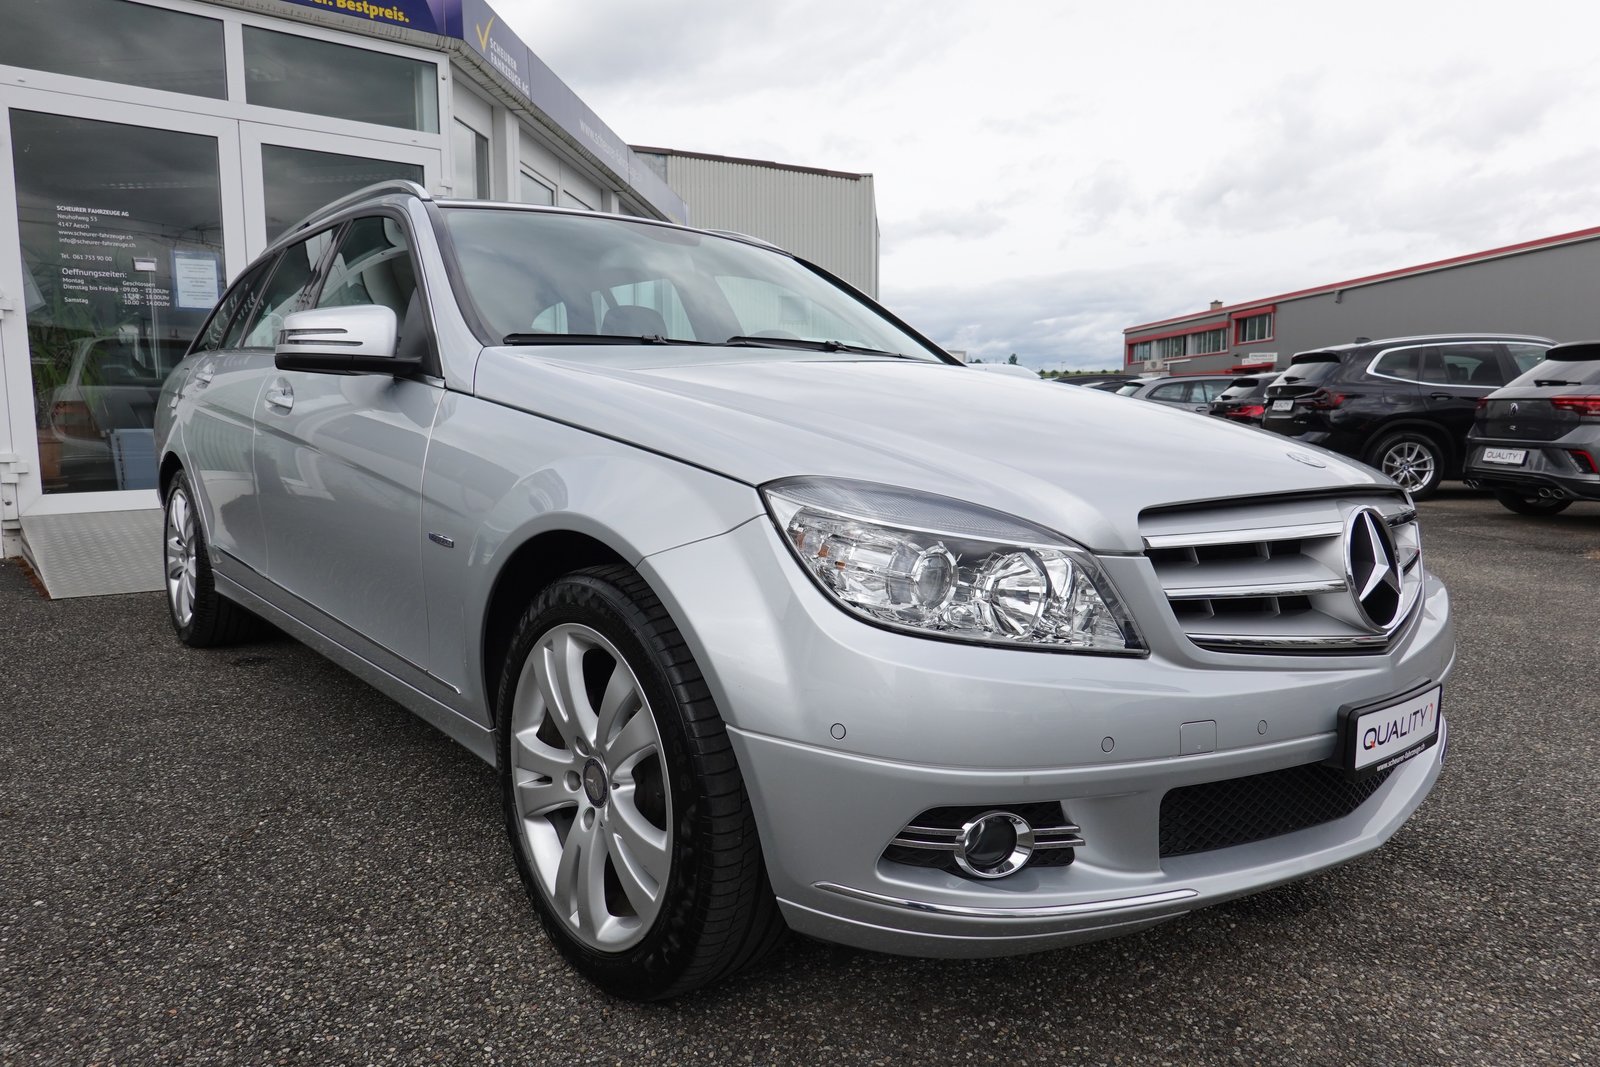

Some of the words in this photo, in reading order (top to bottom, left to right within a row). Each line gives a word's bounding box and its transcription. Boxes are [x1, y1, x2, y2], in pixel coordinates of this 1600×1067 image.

[336, 0, 410, 23] Bestpreis.
[489, 37, 518, 72] SCHEURER
[490, 51, 521, 88] FAHRZEUGE
[56, 205, 87, 213] SCHEURER
[87, 208, 121, 216] FAHRZEUGE
[73, 222, 91, 230] Aesch
[58, 230, 133, 241] www.scheurer-fahrzeuge.ch
[59, 237, 136, 248] info@scheurer-fahrzeuge.ch
[61, 267, 128, 279] Oeffnungszeiten:
[62, 277, 85, 285] Montag
[122, 280, 156, 288] Geschlossen
[63, 283, 89, 292] Dienstag
[98, 285, 119, 293] Freitag
[64, 296, 89, 305] Samstag
